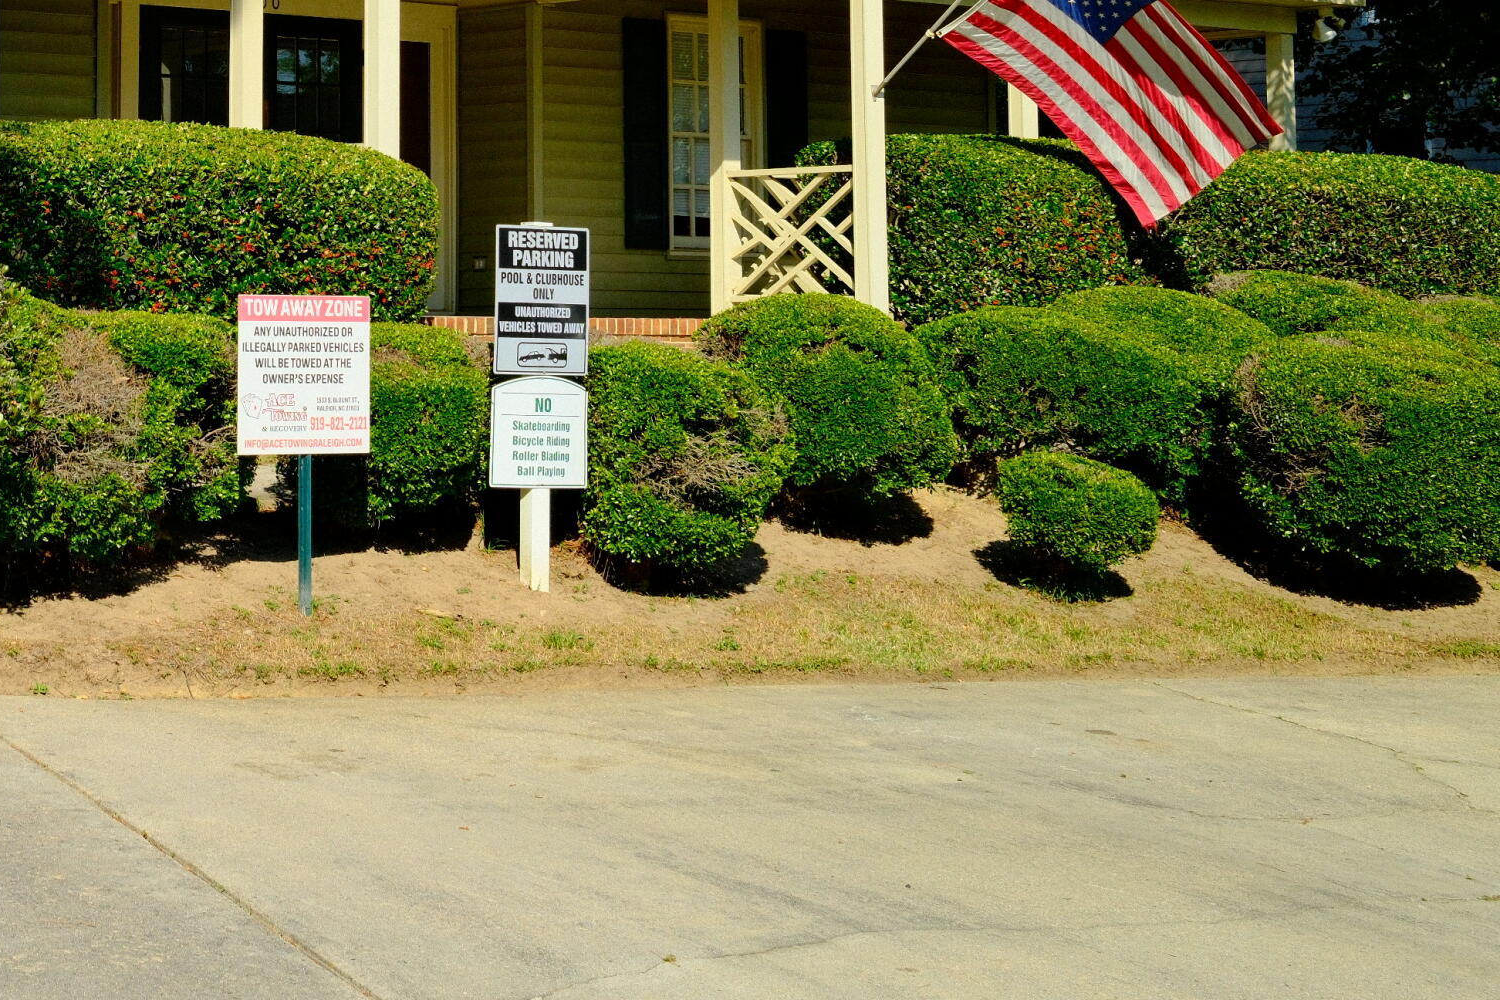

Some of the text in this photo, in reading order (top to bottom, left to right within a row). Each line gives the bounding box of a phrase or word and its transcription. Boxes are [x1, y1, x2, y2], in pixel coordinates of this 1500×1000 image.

[508, 231, 579, 249] RESERVED
[512, 250, 575, 268] PARKING
[501, 272, 584, 286] POOL & CLUBHOUSE
[533, 288, 555, 300] ONLY
[244, 299, 363, 317] TOW AWAY ZONE
[514, 306, 571, 319] UNAUTHORIZED
[253, 326, 353, 337] ANY UNAUTHORIZED OR
[499, 322, 585, 334] VEHICLES TOWED AWAY
[242, 342, 364, 353] ILLEGALLY PARKED VEHICLES
[254, 358, 352, 368] WILL BE TOWED AT THE
[262, 374, 344, 384] OWNER'S EXPENSE
[265, 393, 296, 406] ACE
[534, 397, 552, 412] NO
[310, 416, 367, 431] 919-821-2121
[512, 420, 571, 432] Skateboarding
[244, 437, 362, 450] INFO@ACETOWINGRALEIGH.COM
[512, 436, 570, 447] Bicycle Riding
[512, 450, 570, 463] Roller Blading
[517, 466, 565, 478] Ball Playing
